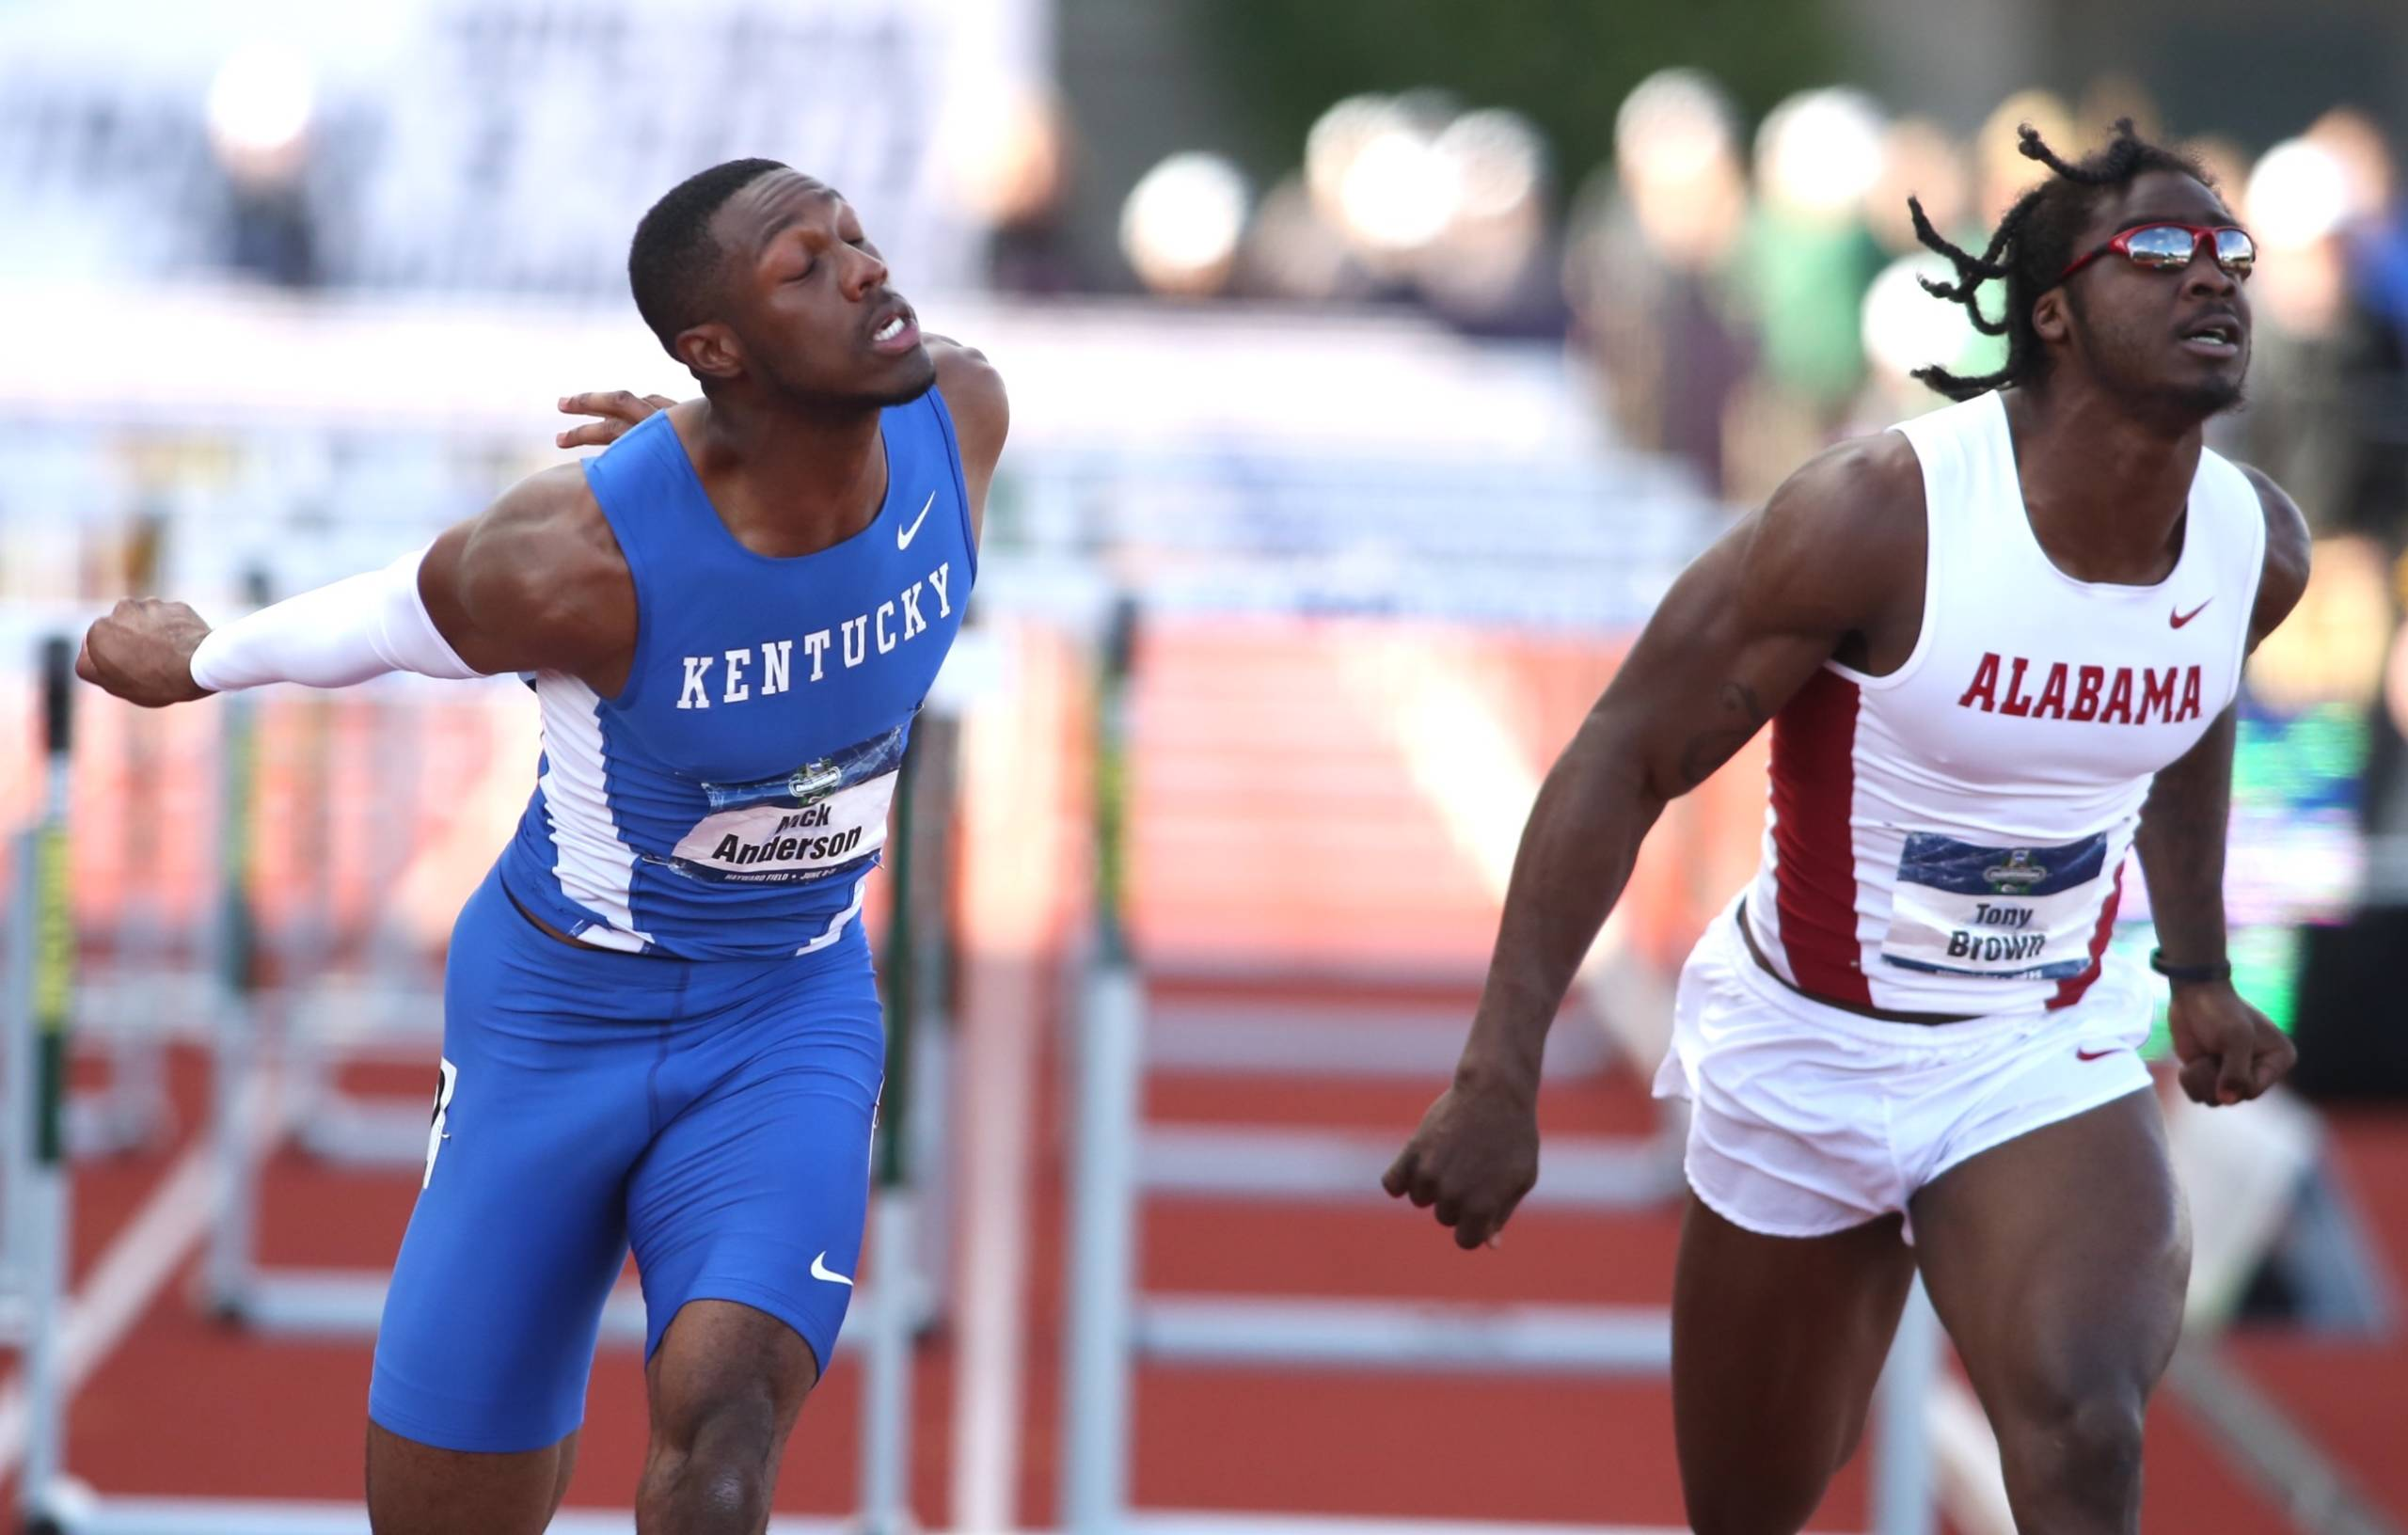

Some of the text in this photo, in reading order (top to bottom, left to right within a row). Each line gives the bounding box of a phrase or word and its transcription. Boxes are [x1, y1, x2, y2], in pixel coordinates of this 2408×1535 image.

[676, 562, 951, 709] KENTUCKY
[1957, 651, 2201, 725] ALABAMA
[712, 825, 863, 864] Anderson
[766, 873, 789, 881] FIELD
[1976, 903, 2034, 929] Tony
[1947, 929, 2046, 961] Brown
